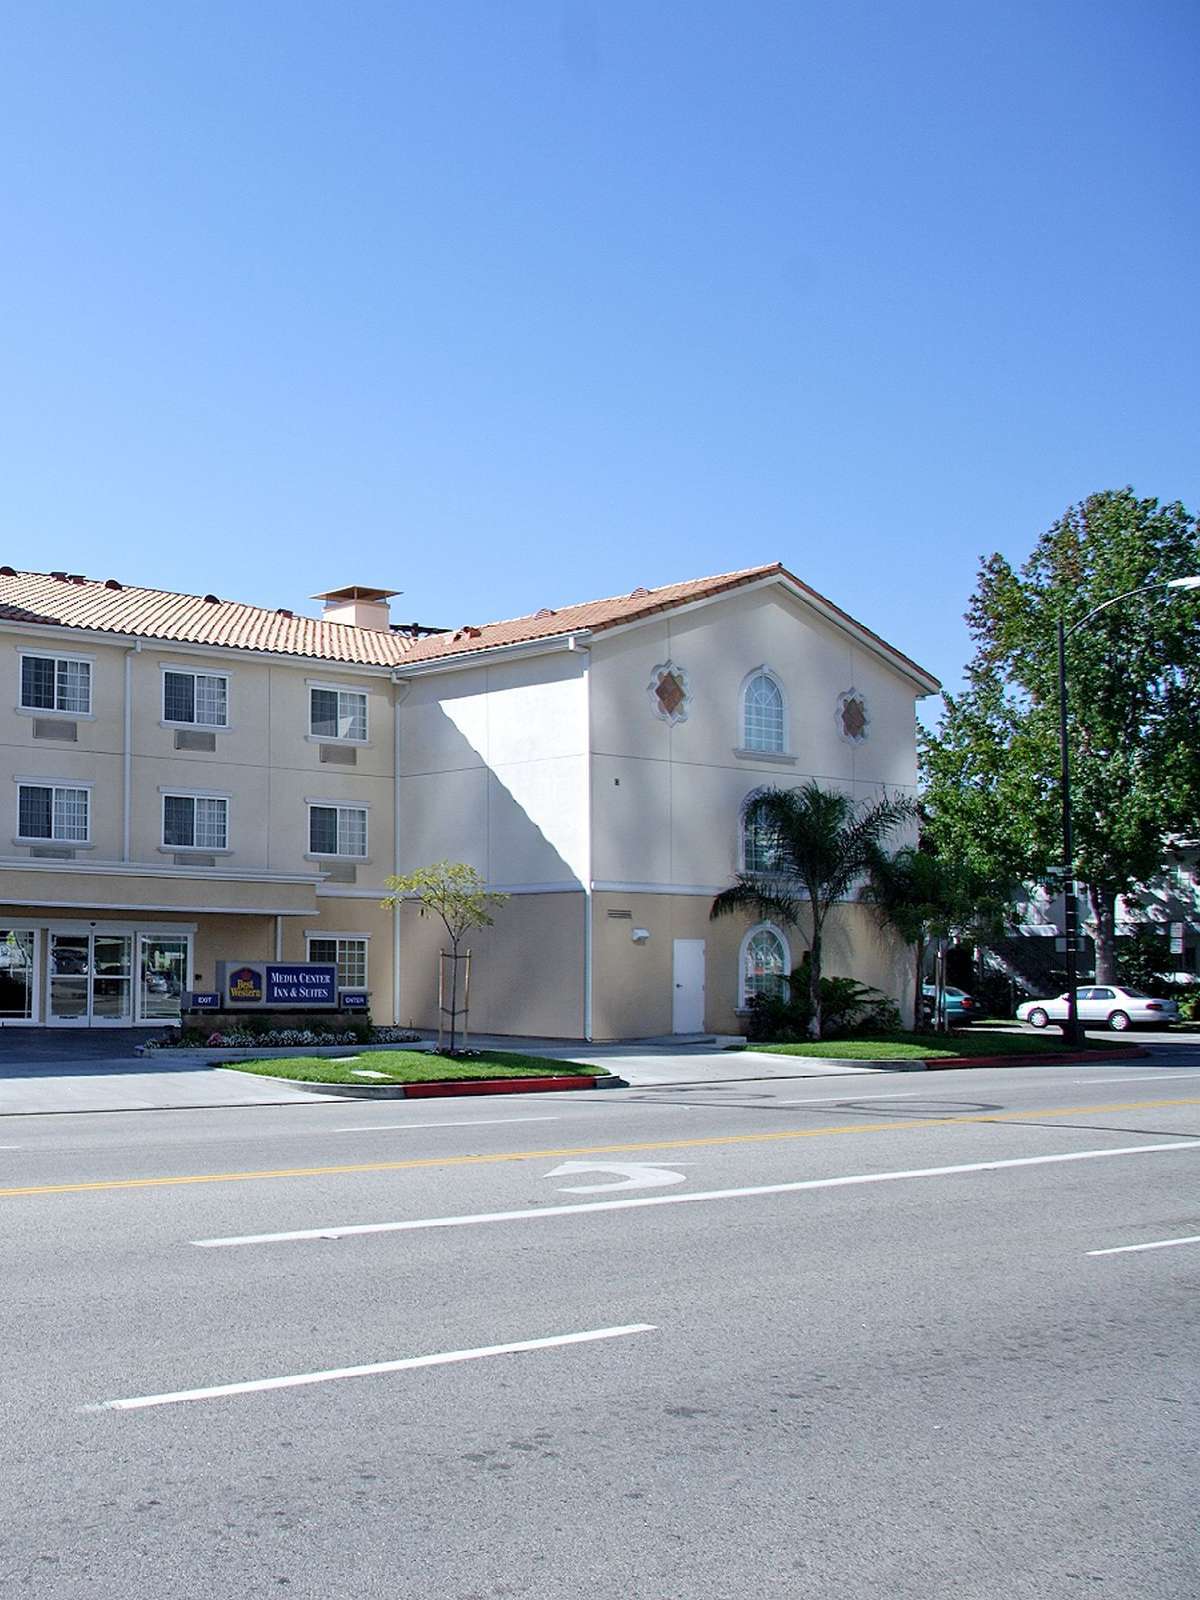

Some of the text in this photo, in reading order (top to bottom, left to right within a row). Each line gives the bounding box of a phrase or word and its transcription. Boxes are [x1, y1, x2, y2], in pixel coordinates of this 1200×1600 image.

[271, 972, 331, 984] MEDIA CENTER
[273, 986, 329, 998] INN & SUITES
[198, 996, 212, 1004] EXIT
[345, 997, 364, 1005] ENTER
